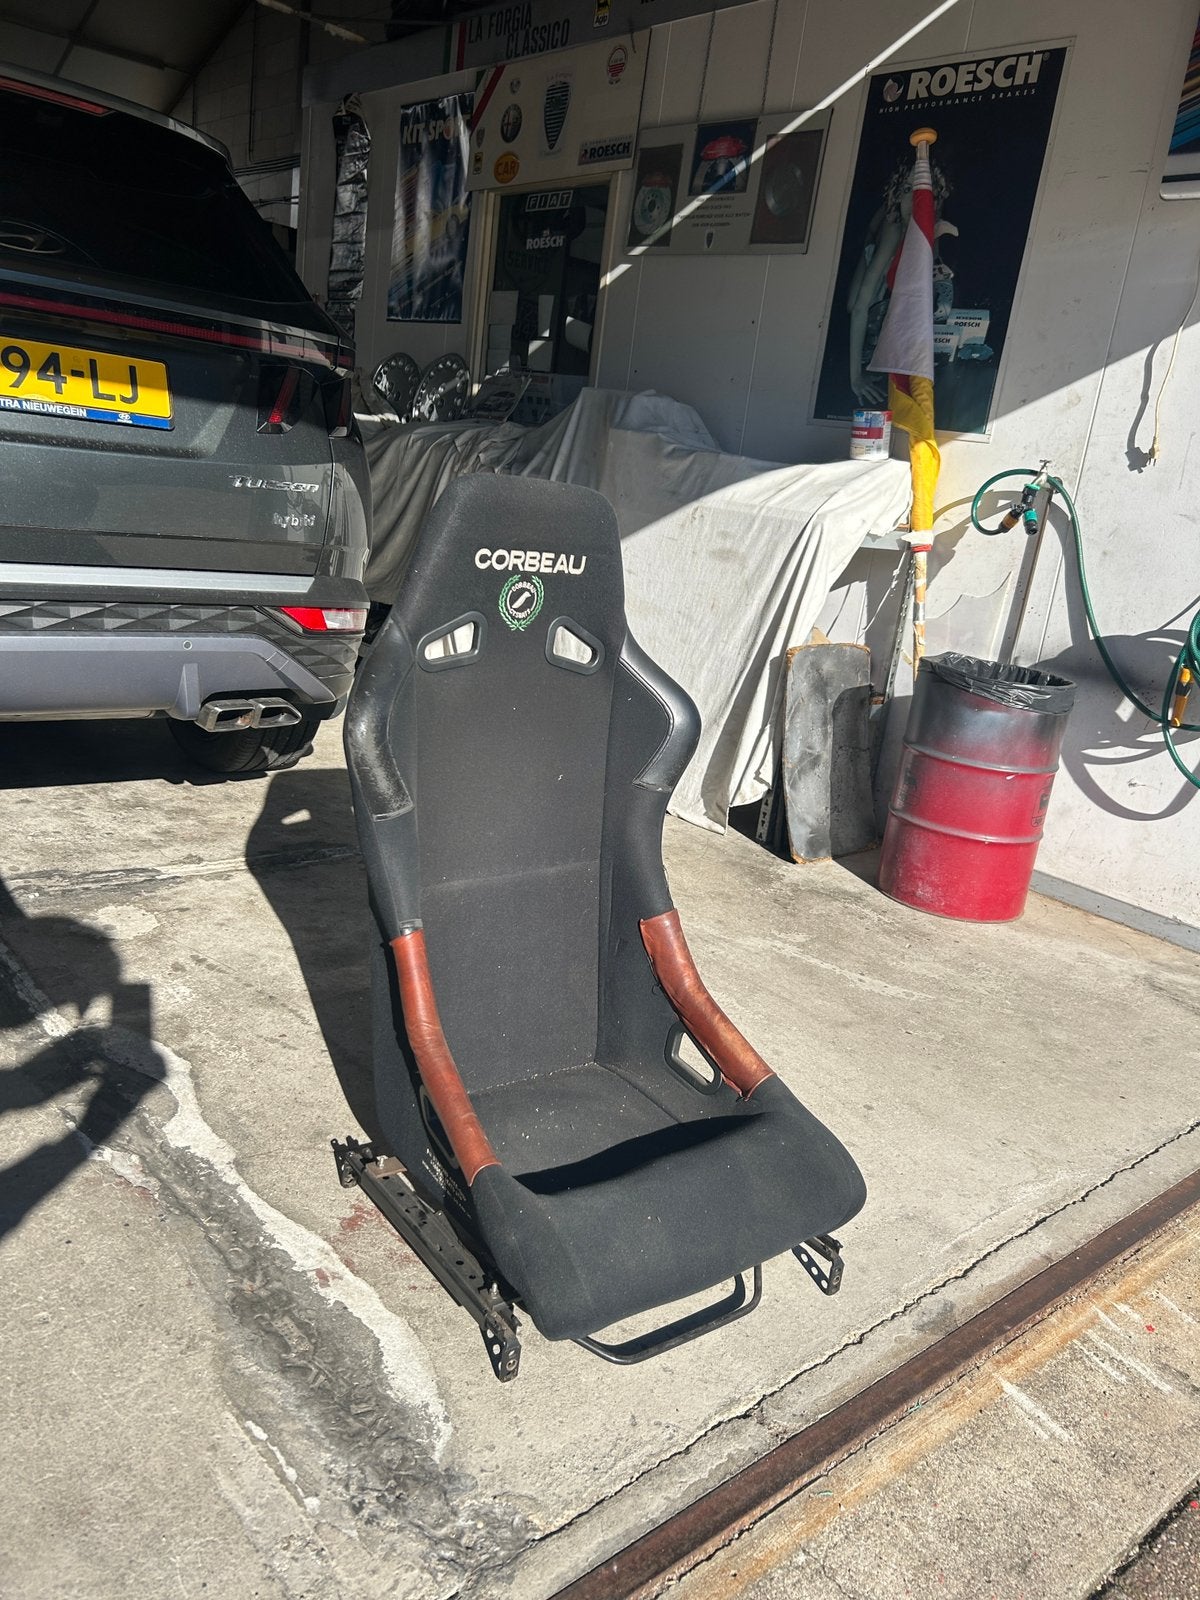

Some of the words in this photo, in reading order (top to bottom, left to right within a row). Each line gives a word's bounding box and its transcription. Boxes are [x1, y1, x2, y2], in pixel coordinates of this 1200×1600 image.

[468, 15, 483, 43] LA
[487, 3, 533, 39] FORGIA
[505, 18, 571, 59] CLASSICO
[907, 51, 1044, 101] ROESCH
[878, 105, 900, 114] HIGH
[903, 95, 983, 112] PERFORMANCE
[991, 88, 1037, 100] BRAKES
[402, 122, 426, 144] KIT
[589, 142, 631, 160] ROESCH
[527, 192, 572, 210] FIAT
[526, 235, 565, 250] ROESCH
[0, 345, 139, 405] 94-LJ
[22, 400, 87, 417] NIEUWEGEIN
[474, 547, 587, 575] CORBEAU
